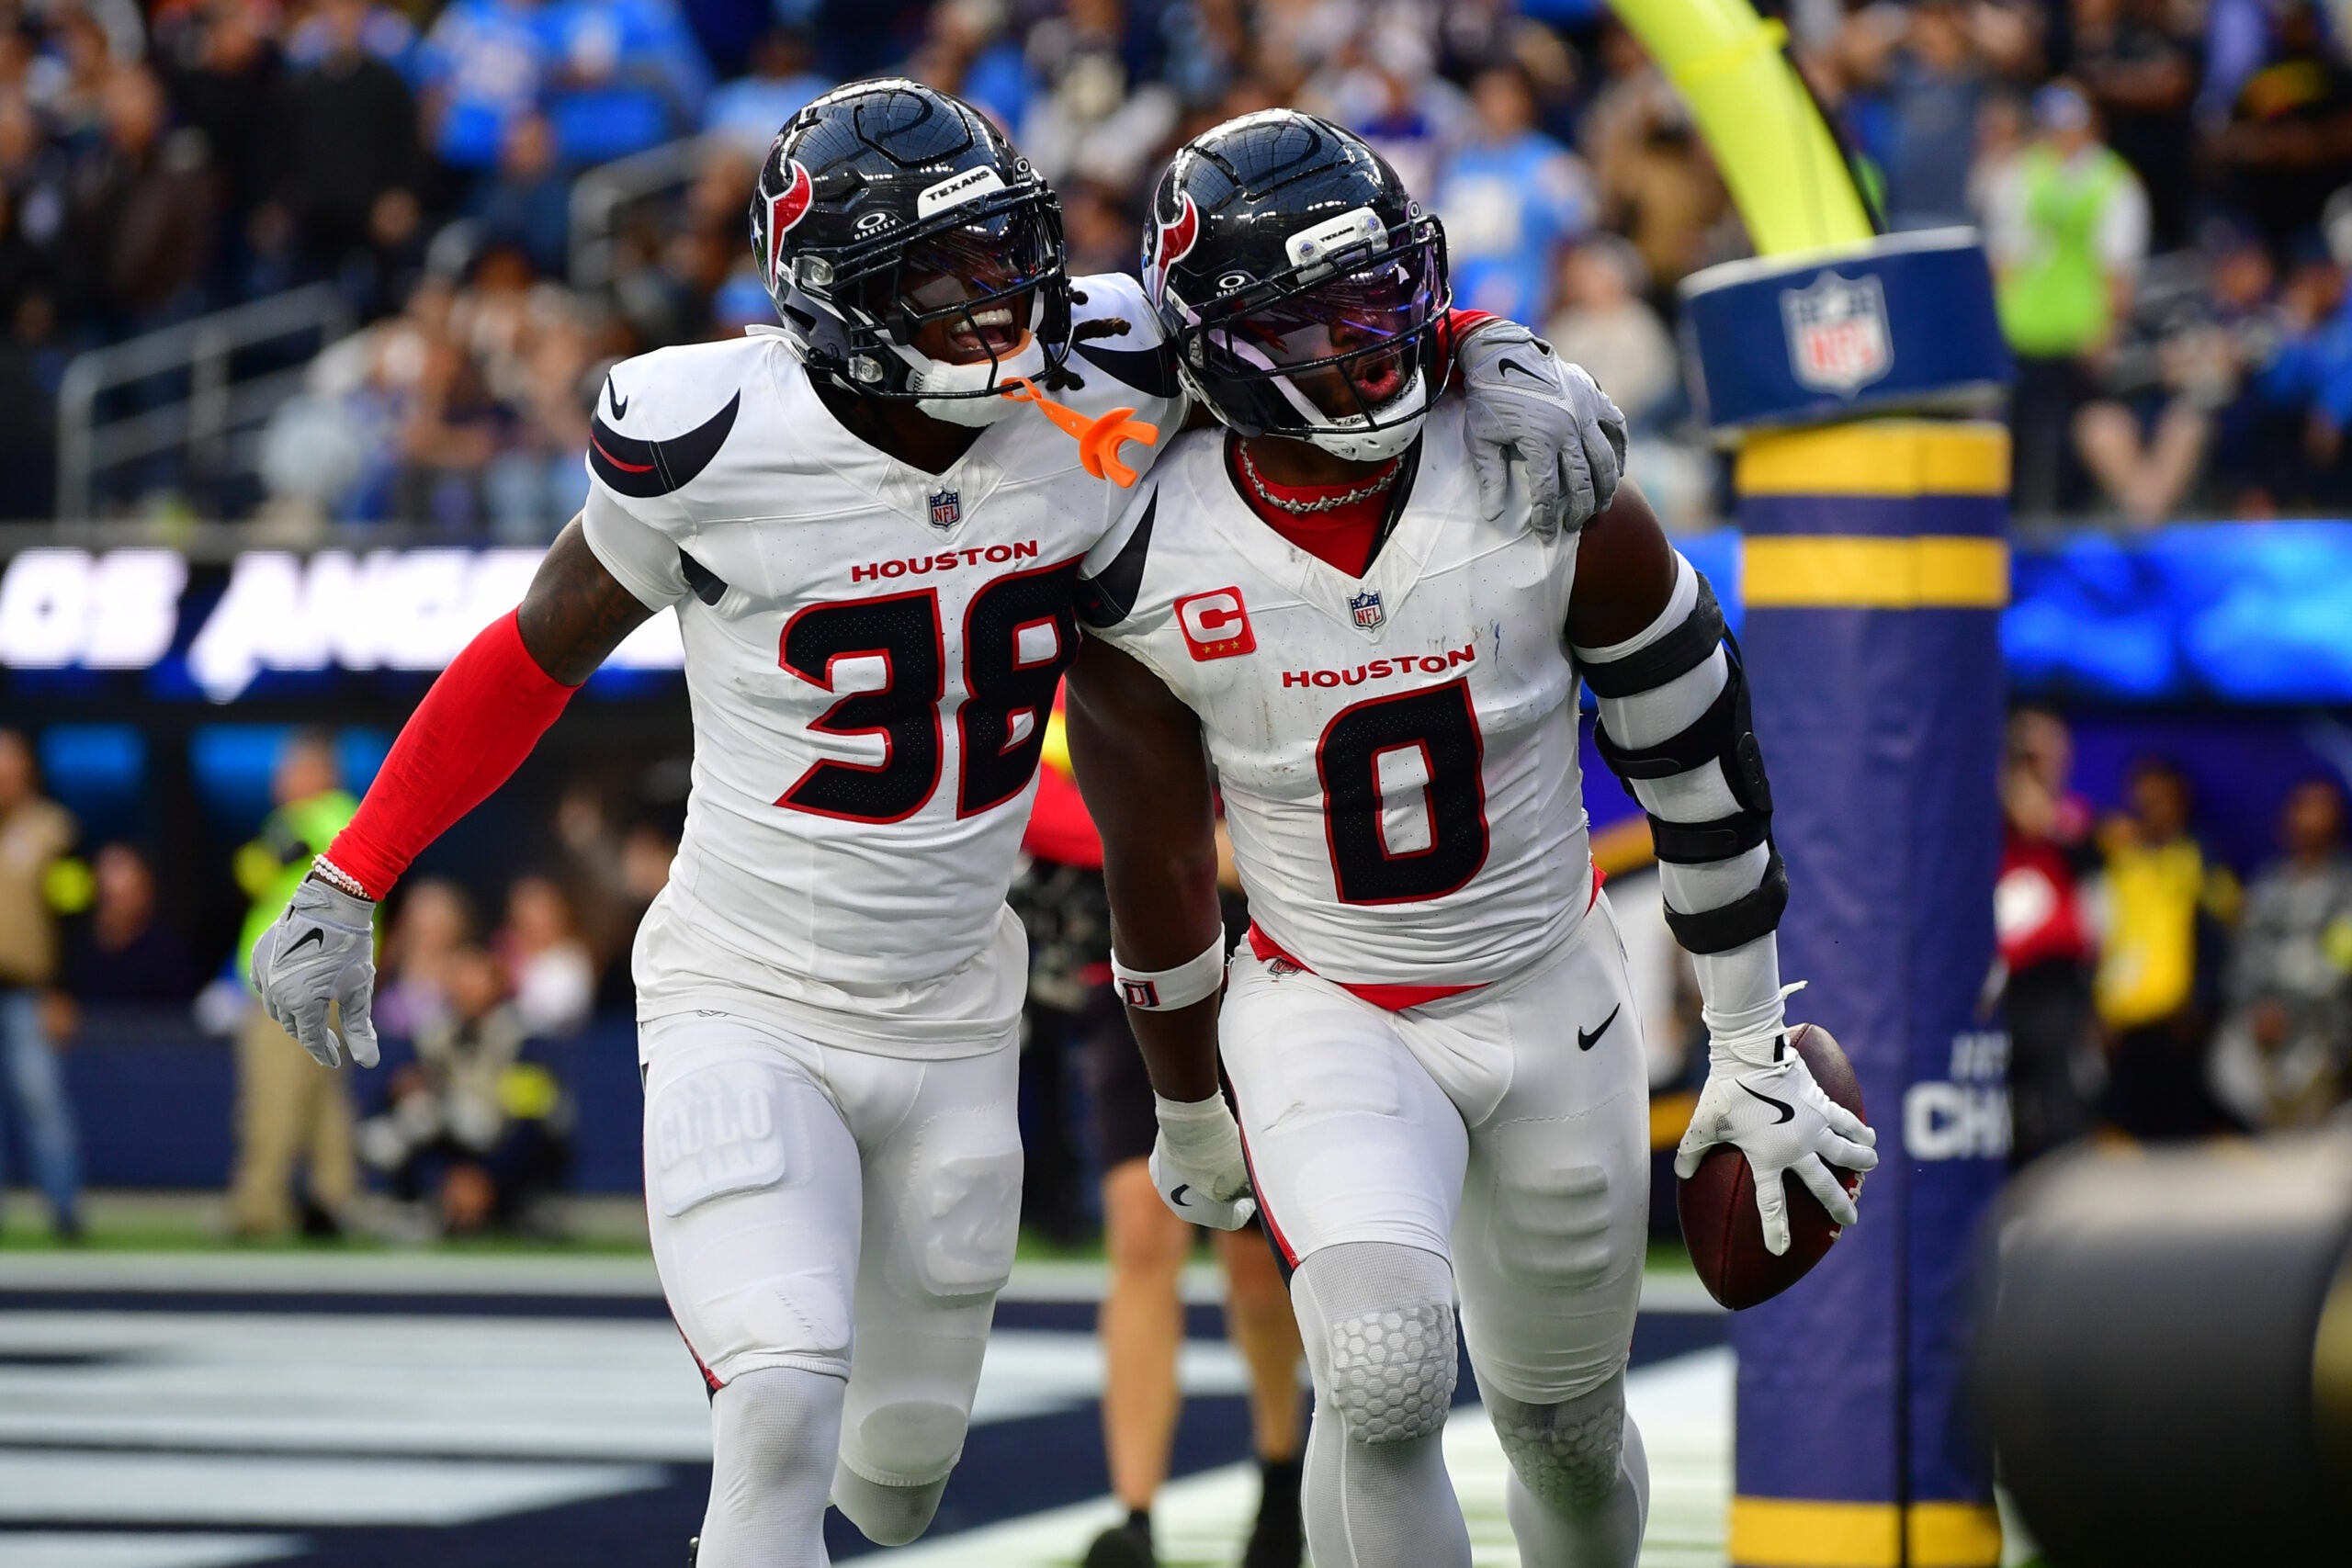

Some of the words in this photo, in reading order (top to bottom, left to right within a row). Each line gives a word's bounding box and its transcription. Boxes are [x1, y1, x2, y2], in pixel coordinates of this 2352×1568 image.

[926, 170, 990, 201] TEXANS
[854, 218, 897, 241] OAKLEY
[1319, 226, 1355, 243] TEXANS
[933, 505, 957, 524] NFL
[852, 540, 1038, 582] HOUSTON
[1182, 592, 1243, 643] C
[1355, 607, 1382, 626] NFL
[1283, 644, 1476, 688] HOUSTON
[773, 551, 1088, 825] 38
[1316, 676, 1490, 906] 0
